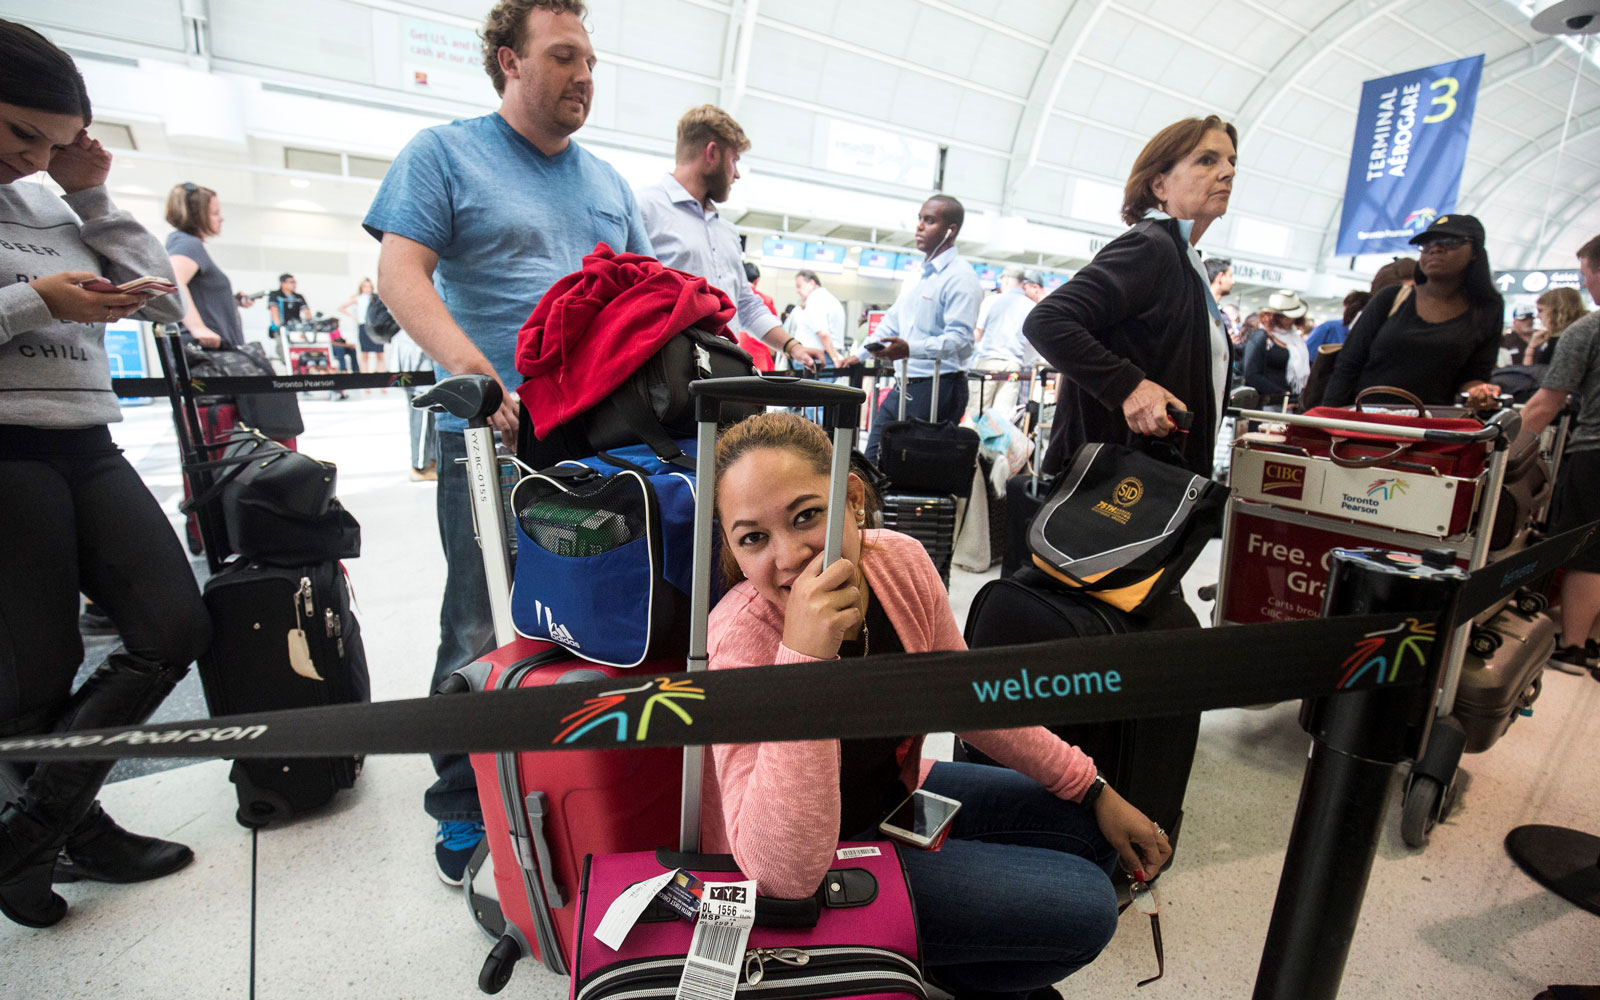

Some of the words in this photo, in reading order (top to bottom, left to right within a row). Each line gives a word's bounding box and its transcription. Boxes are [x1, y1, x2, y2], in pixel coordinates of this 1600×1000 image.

[1422, 76, 1459, 124] 3
[1366, 87, 1398, 182] TERMINAL
[1388, 81, 1421, 177] AÉROGARE
[0, 239, 61, 256] BEER
[19, 345, 87, 361] CHILL
[272, 380, 303, 389] Toronto
[304, 380, 335, 388] Pearson
[1266, 464, 1303, 481] CIBC
[1118, 484, 1138, 500] SID
[1342, 493, 1379, 507] Toronto
[1341, 501, 1378, 515] Pearson
[1248, 533, 1312, 568] Free.
[1267, 597, 1294, 611] Carts
[1260, 606, 1283, 620] CIBC
[551, 633, 580, 648] adidas
[972, 668, 1122, 703] welcome
[101, 724, 269, 746] Pearson
[712, 888, 745, 901] YYZ
[700, 913, 720, 921] MSP
[702, 902, 712, 914] DL
[718, 904, 737, 917] 1556
